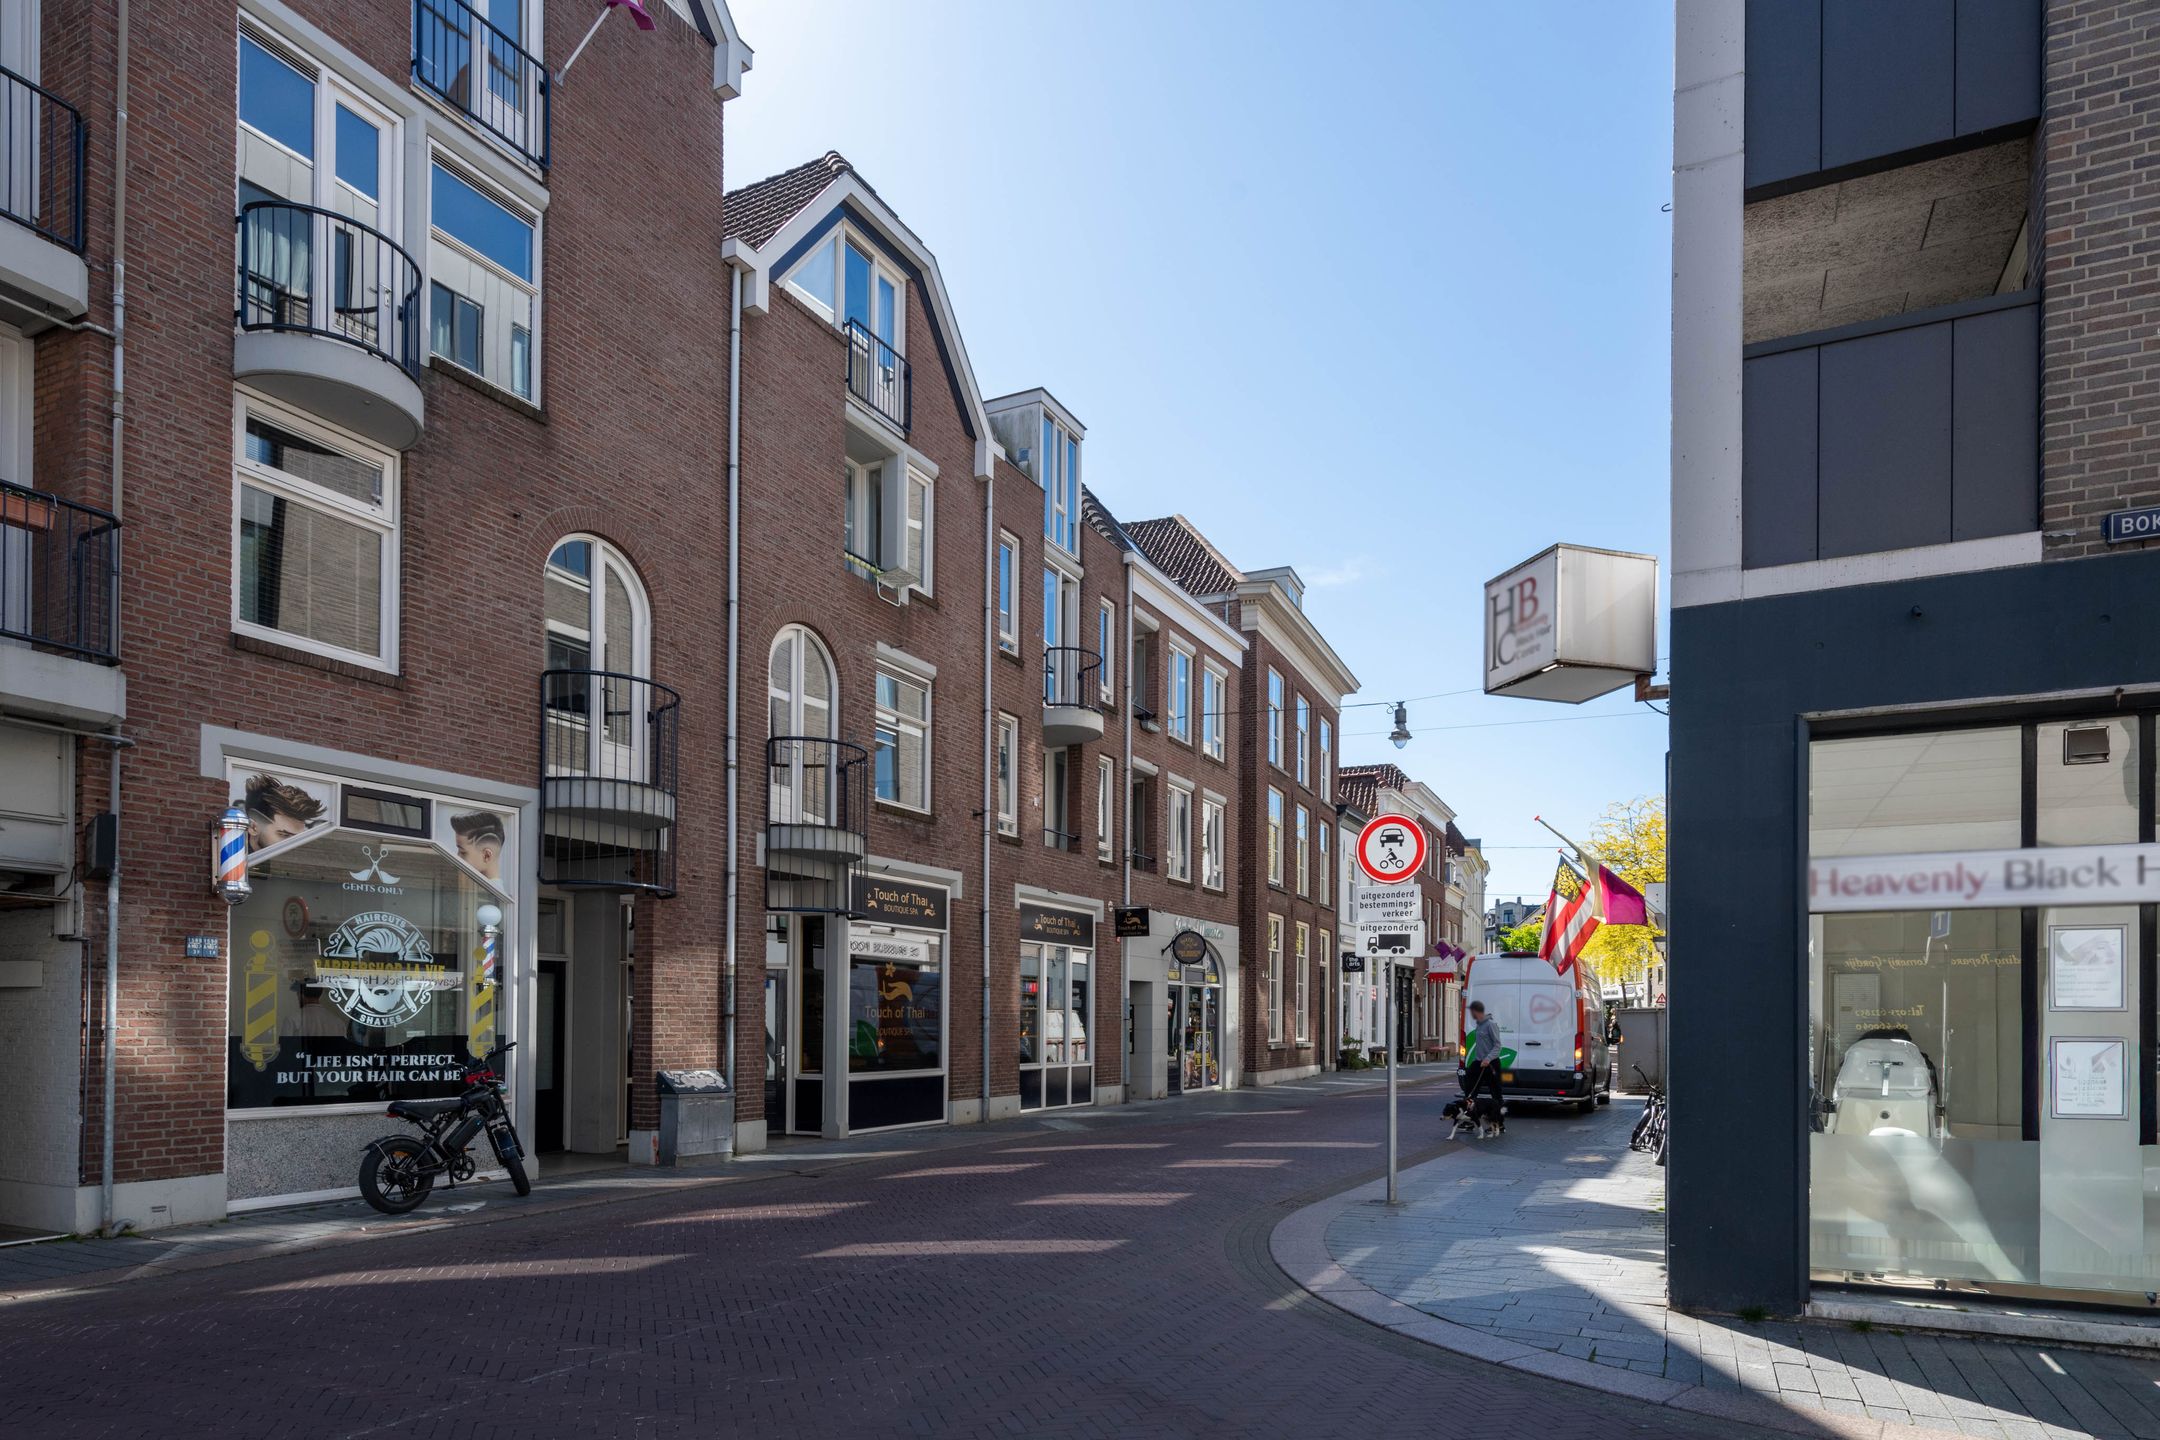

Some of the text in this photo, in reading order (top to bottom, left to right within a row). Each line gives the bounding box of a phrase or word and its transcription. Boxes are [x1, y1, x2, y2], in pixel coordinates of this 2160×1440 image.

[2121, 514, 2160, 534] BOK
[1809, 862, 1987, 900] Heavenly
[2003, 856, 2121, 891] Black
[342, 882, 404, 895] GENTS ONLY
[1361, 890, 1415, 900] uitgezonderd
[873, 887, 928, 906] Touch of Thai
[1360, 900, 1416, 909] bestemmings-
[1382, 909, 1413, 917] verkeer
[355, 913, 406, 927] HAIRCUTS
[1040, 914, 1057, 925] Touch
[1057, 916, 1064, 926] of
[1360, 924, 1419, 933] uitgezonderd
[864, 1005, 925, 1018] Touch of Thai
[359, 1014, 401, 1026] SHAVES
[277, 1071, 312, 1084] BUT
[316, 1071, 363, 1083] YOUR
[367, 1070, 406, 1082] HAIR
[409, 1070, 439, 1082] CAN
